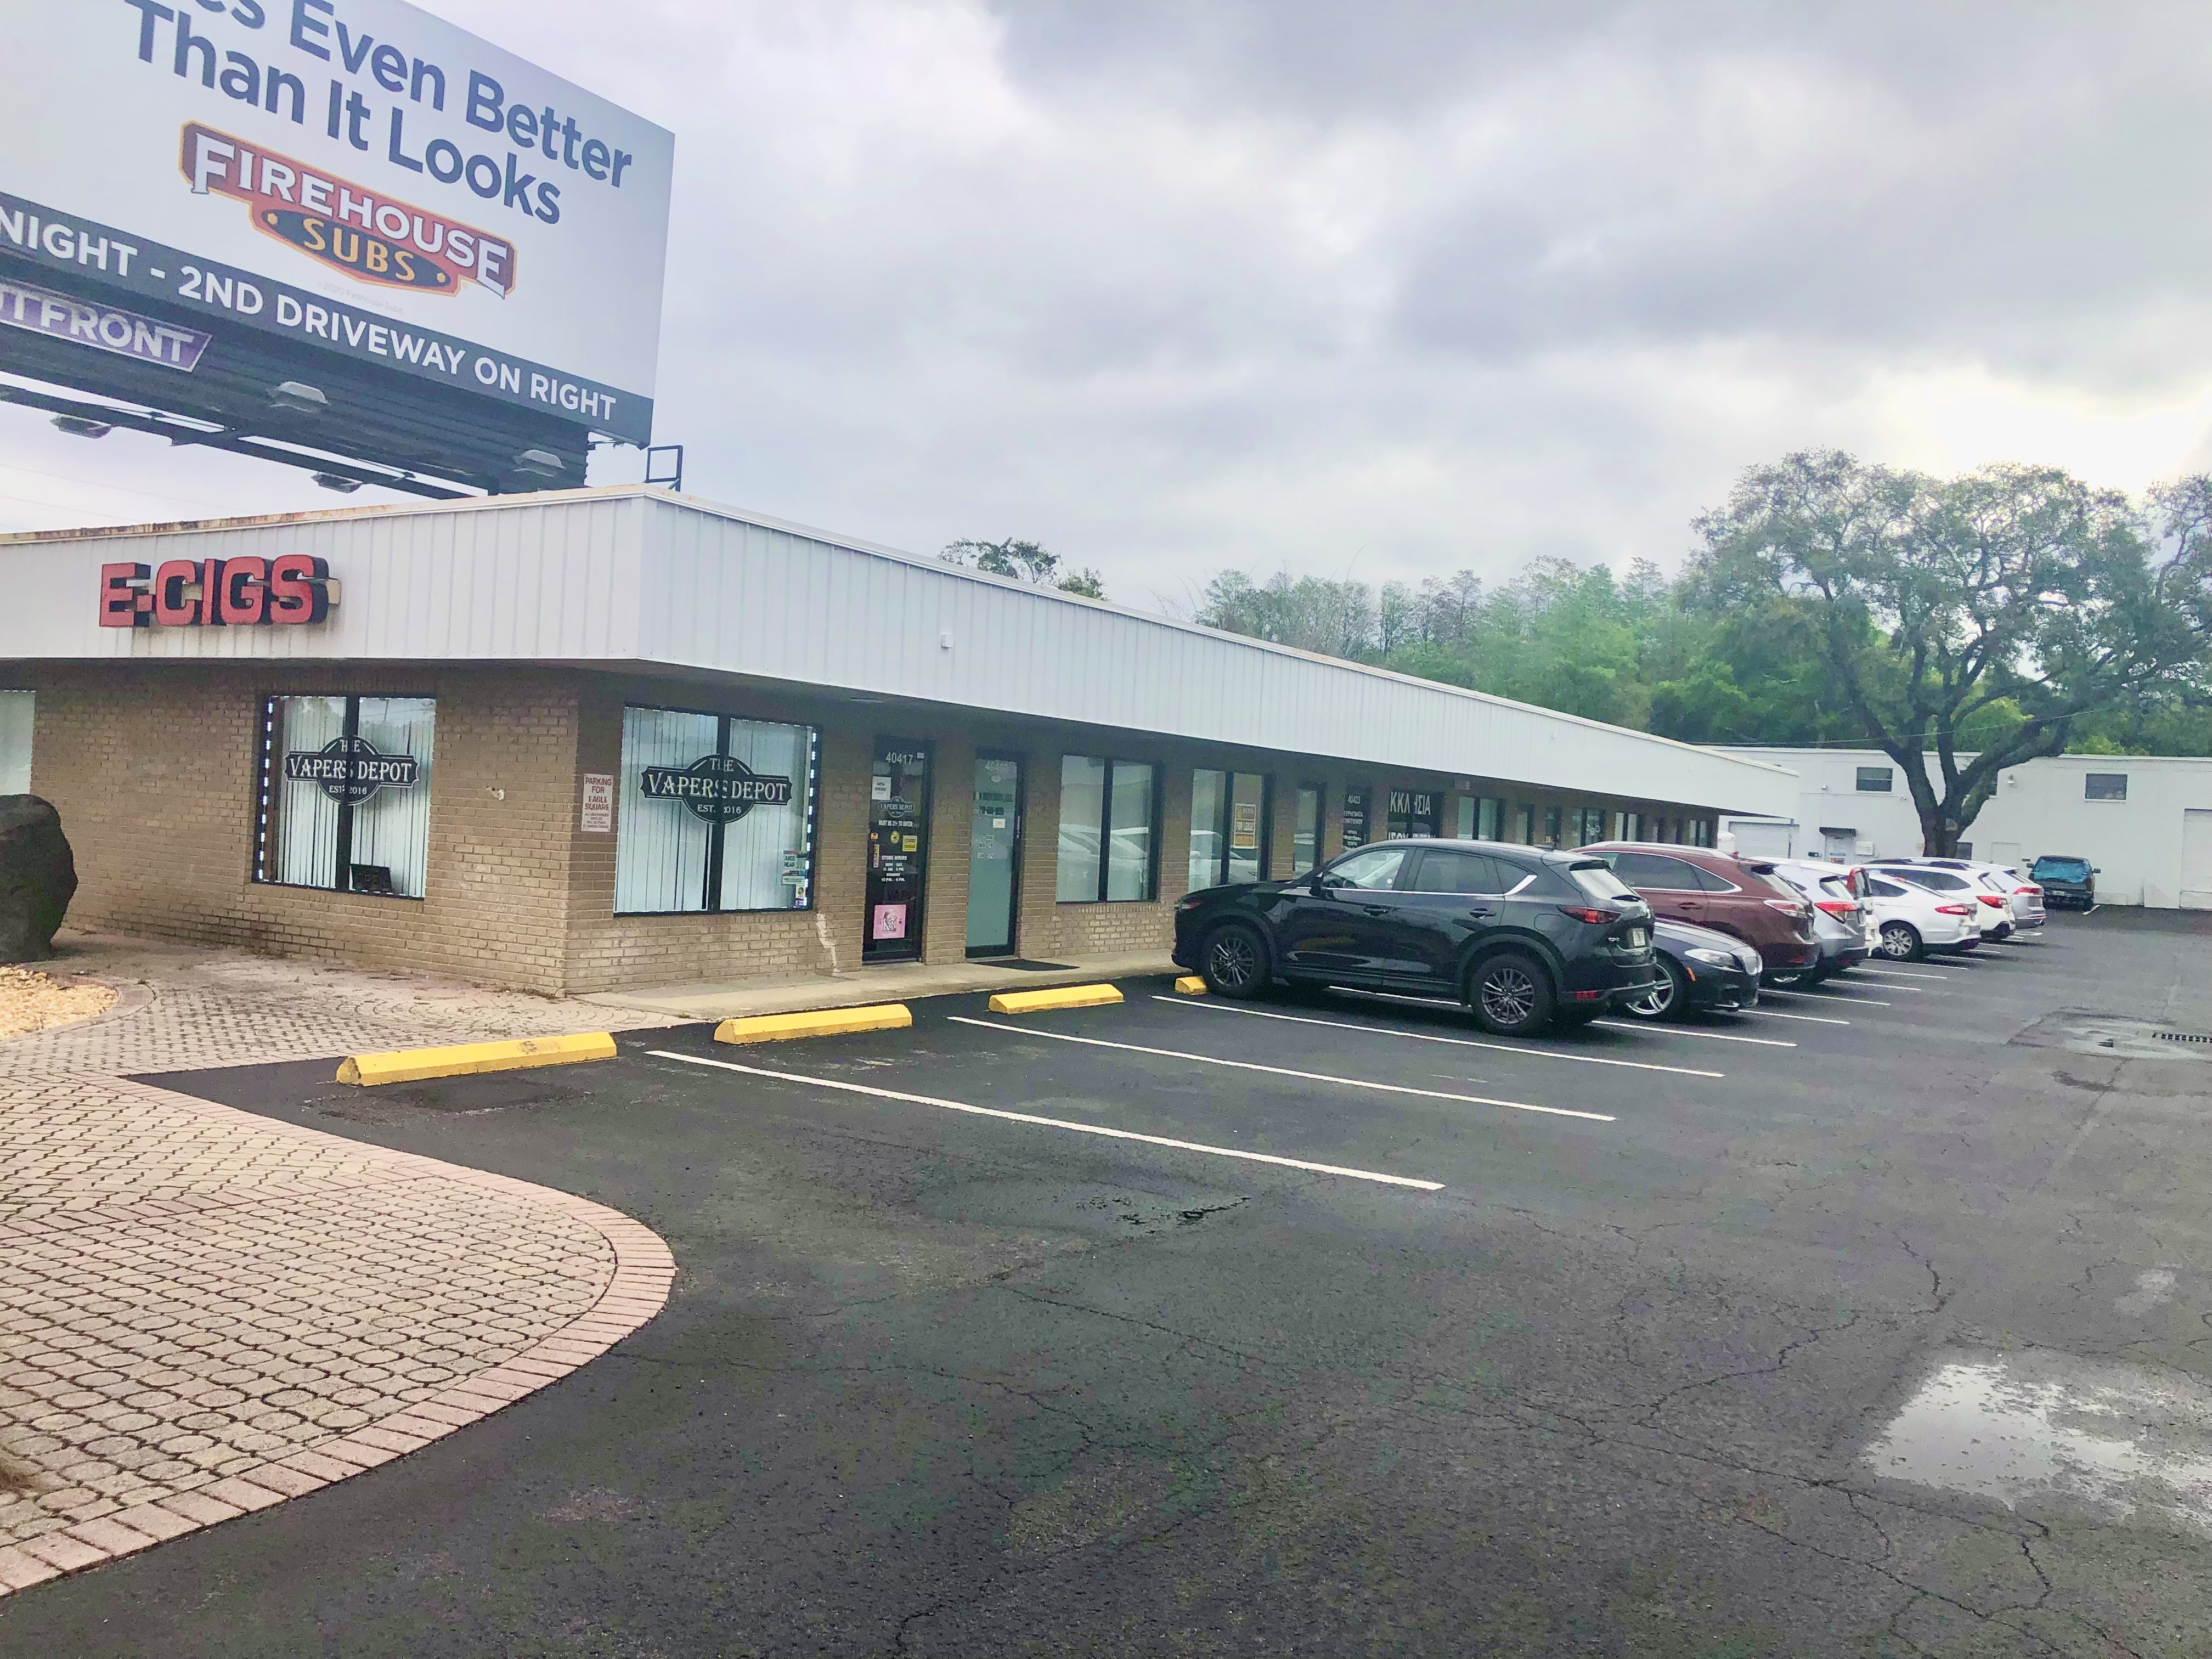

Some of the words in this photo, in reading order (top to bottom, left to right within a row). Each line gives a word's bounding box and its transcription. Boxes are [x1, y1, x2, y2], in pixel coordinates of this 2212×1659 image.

[124, 0, 305, 125] Than
[328, 80, 370, 151] It
[389, 106, 561, 224] Looks
[290, 0, 445, 112] Even
[466, 69, 632, 188] Better
[190, 132, 508, 299] FIREHOUSE
[303, 218, 416, 281] SUBS
[178, 266, 263, 314] 2ND
[276, 293, 465, 374] DRIVEWAY
[475, 357, 521, 394] ON
[530, 373, 616, 421] RIGHT
[358, 760, 412, 782] DEPOT
[585, 777, 612, 786] PARKING
[886, 752, 913, 765] 40417
[732, 780, 787, 801] DEPOT
